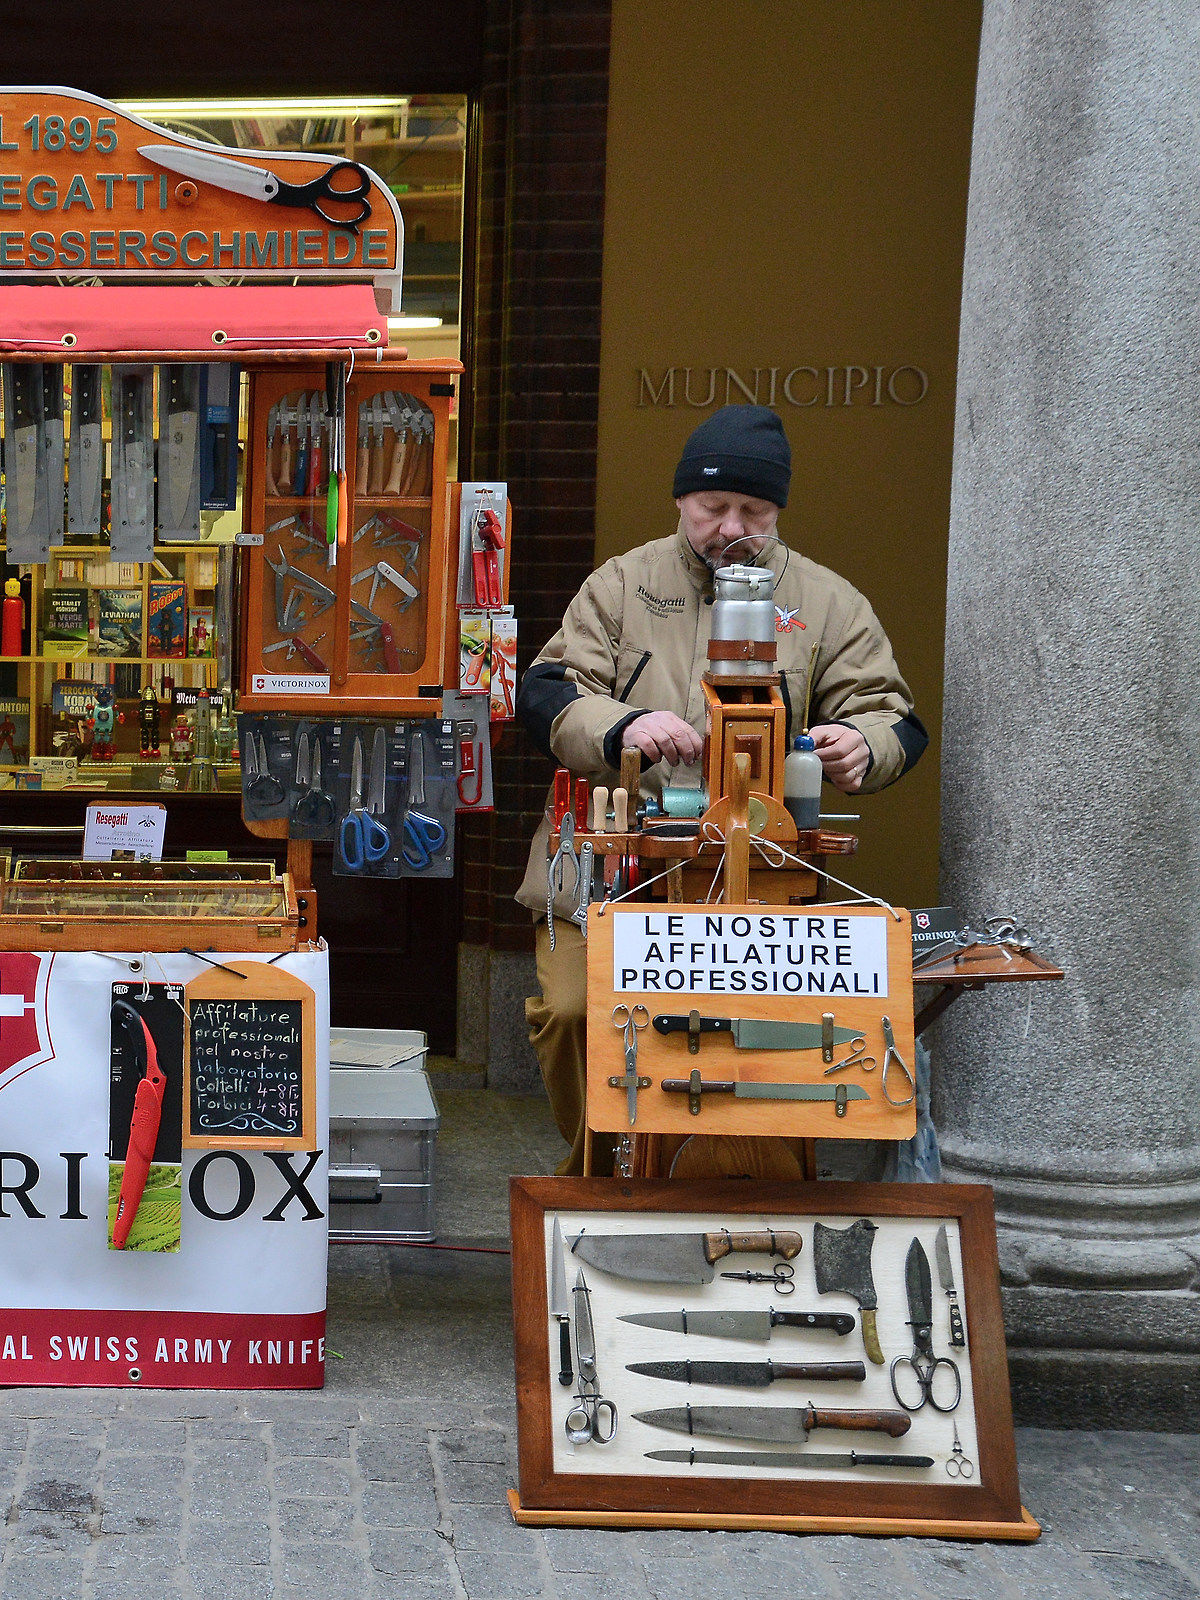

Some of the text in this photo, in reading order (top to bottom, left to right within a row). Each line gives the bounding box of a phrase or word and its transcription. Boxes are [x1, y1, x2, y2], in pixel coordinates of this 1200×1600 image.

[23, 116, 118, 154] 1895
[635, 366, 930, 407] MUNICIPIO
[150, 587, 184, 616] ROBOT
[101, 611, 140, 619] LEVIATHAN
[271, 680, 327, 688] VICTORINOX
[95, 810, 129, 828] Resegatti
[644, 915, 850, 939] LE NOSTRE
[912, 930, 957, 942] TORINOX
[644, 942, 852, 966] AFFILATURE
[621, 968, 879, 994] PROFESSIONALI
[193, 1002, 290, 1026] Affilature
[195, 1022, 299, 1044] professionali
[196, 1043, 288, 1060] nel nostro
[197, 1059, 298, 1080] laboratorio
[196, 1075, 250, 1094] Coltelli
[197, 1094, 252, 1110] Forbici
[49, 1335, 140, 1362] SWISS
[154, 1337, 232, 1364] ARMY
